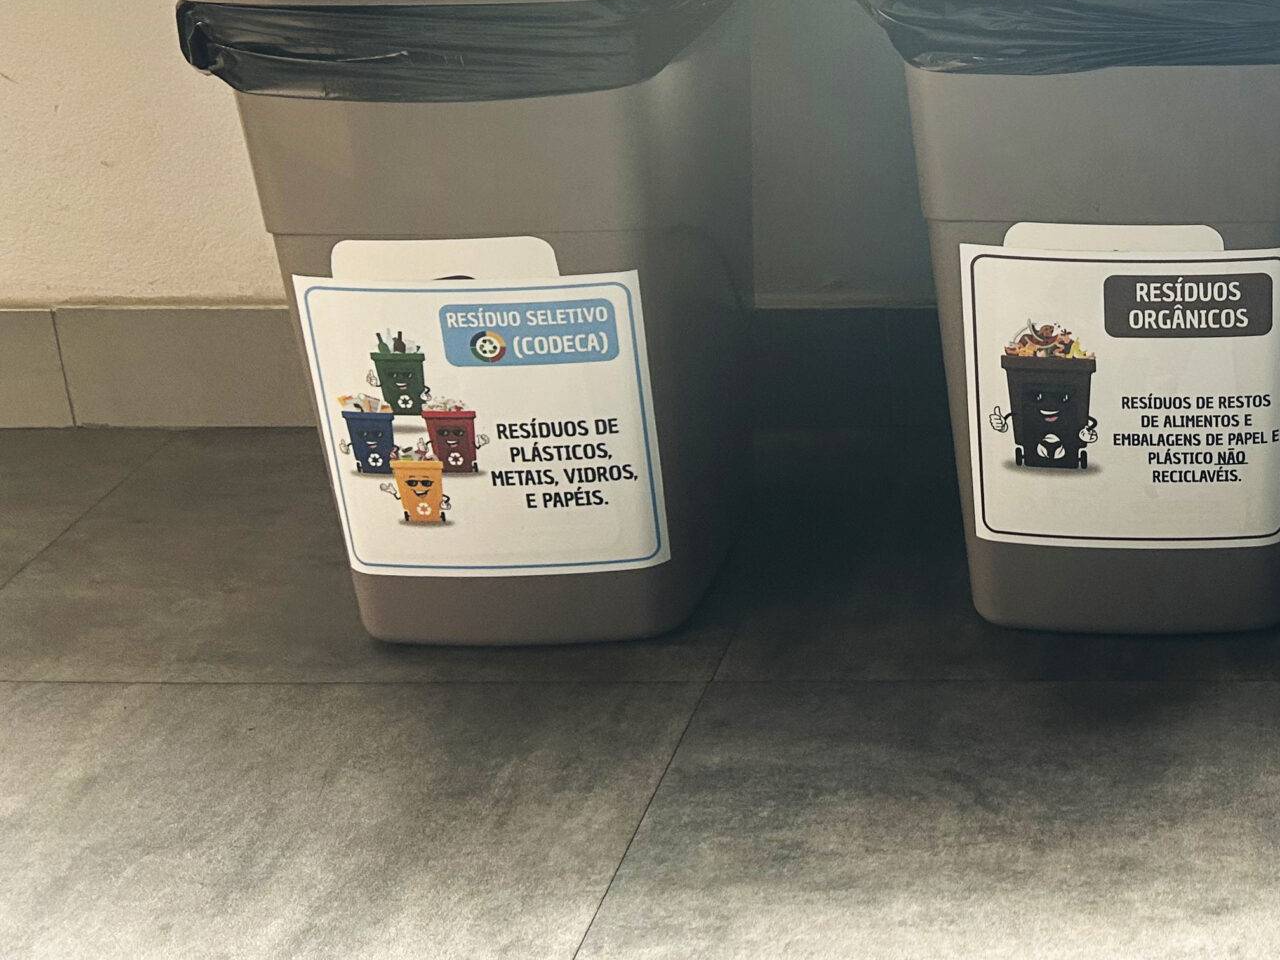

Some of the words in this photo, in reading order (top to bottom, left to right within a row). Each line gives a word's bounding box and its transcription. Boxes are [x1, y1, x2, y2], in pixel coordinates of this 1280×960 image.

[1135, 277, 1242, 303] RESÍDUOS
[446, 307, 521, 328] RESÍDUO
[525, 306, 608, 326] SELETIVO
[1128, 304, 1249, 330] ORGÂNICOS
[513, 332, 609, 358] (CODECA)
[1121, 393, 1191, 409] RESÍDUOS
[1196, 396, 1214, 409] DE
[1218, 394, 1271, 409] RESTOS
[496, 418, 589, 440] RESÍDUOS
[594, 418, 619, 435] DE
[1141, 415, 1159, 428] DE
[1163, 414, 1240, 428] ALIMENTOS
[1244, 414, 1252, 426] E
[1113, 433, 1201, 446] EMBALAGENS
[1206, 433, 1223, 446] DE
[1228, 431, 1268, 445] PAPEL
[1272, 429, 1280, 442] E
[509, 442, 613, 463] PLÁSTICOS,
[1148, 448, 1213, 464] PLÁSTICO
[1217, 448, 1246, 465] NÃO
[490, 469, 559, 487] METAIS,
[563, 464, 638, 484] VIDROS,
[1152, 466, 1242, 483] RECICLAVÉIS.
[526, 493, 537, 509] E
[542, 487, 609, 508] PAPÉIS.
